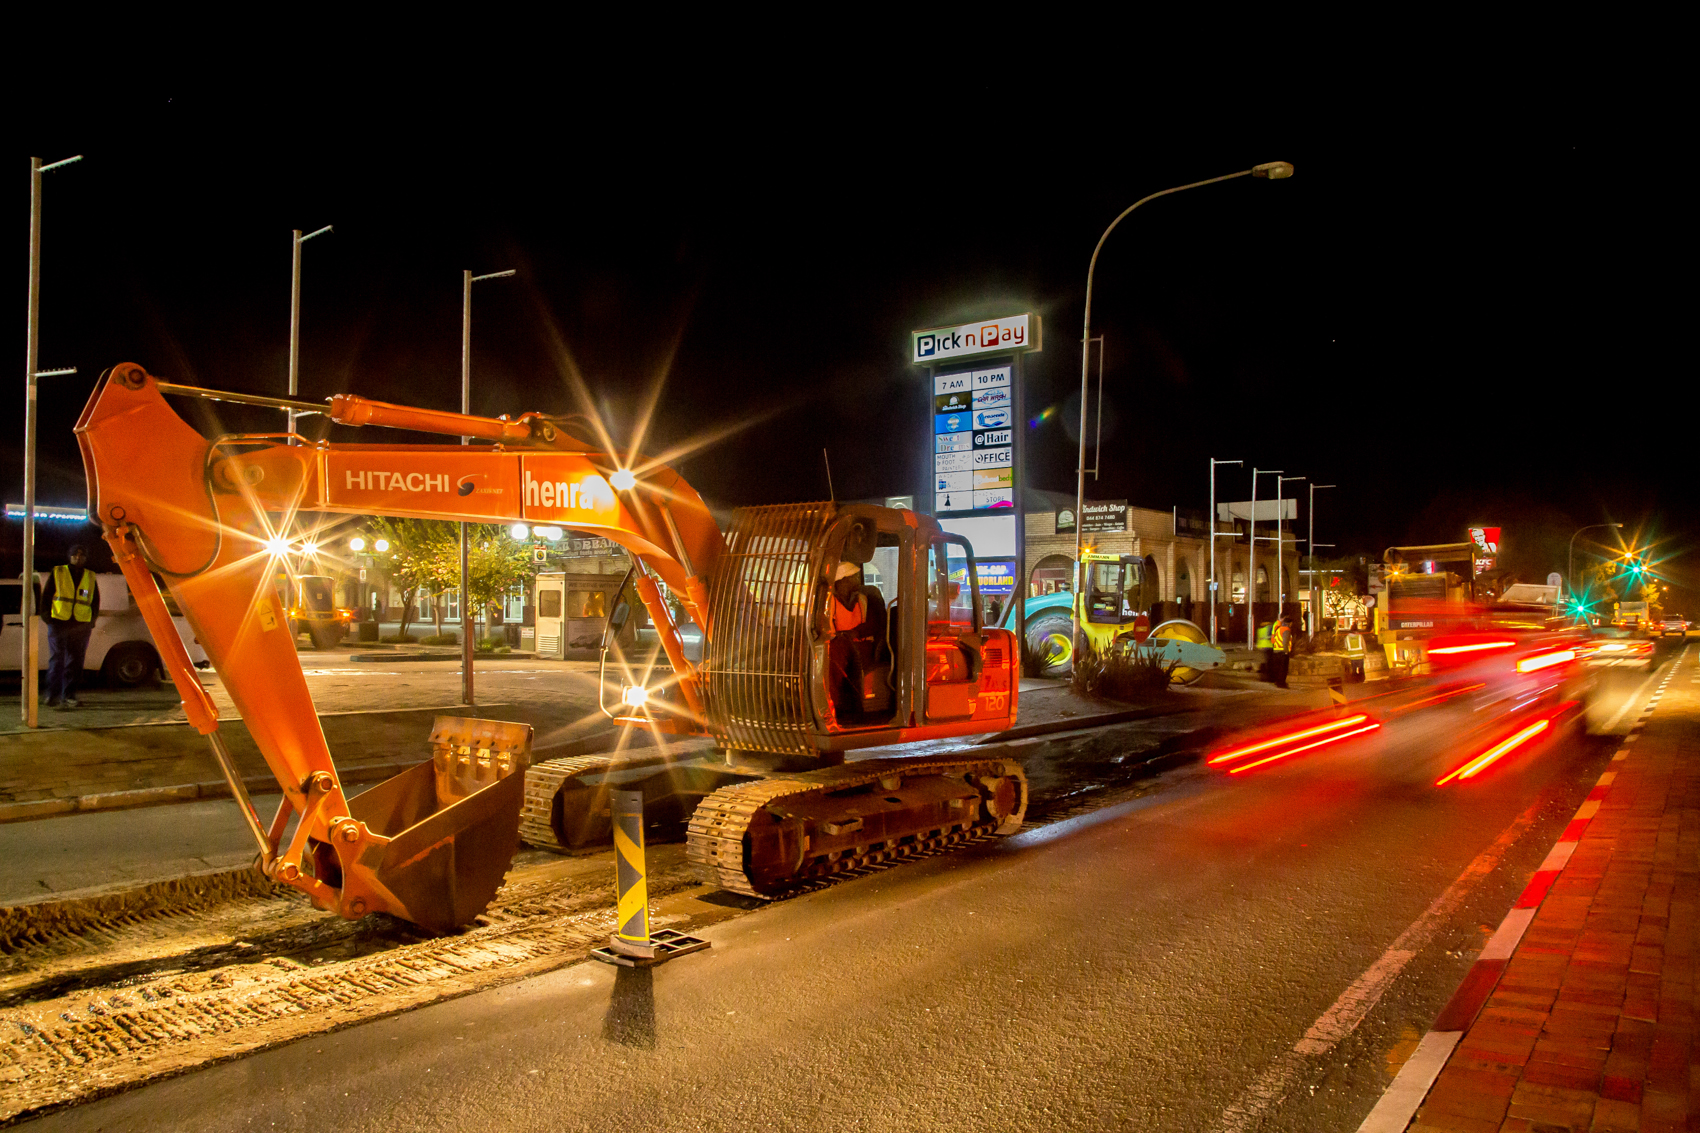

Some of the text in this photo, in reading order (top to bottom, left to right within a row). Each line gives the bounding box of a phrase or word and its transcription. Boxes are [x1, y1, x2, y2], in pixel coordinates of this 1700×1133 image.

[918, 324, 1024, 357] Pick n Pay
[942, 380, 964, 390] 7 AM
[977, 373, 1005, 384] 10 PM
[974, 451, 1011, 464] OFFICE
[345, 470, 450, 493] HITACHI
[525, 470, 594, 510] henra
[1108, 503, 1126, 514] Shop
[1475, 558, 1492, 566] KFC
[985, 696, 1005, 711] 120
